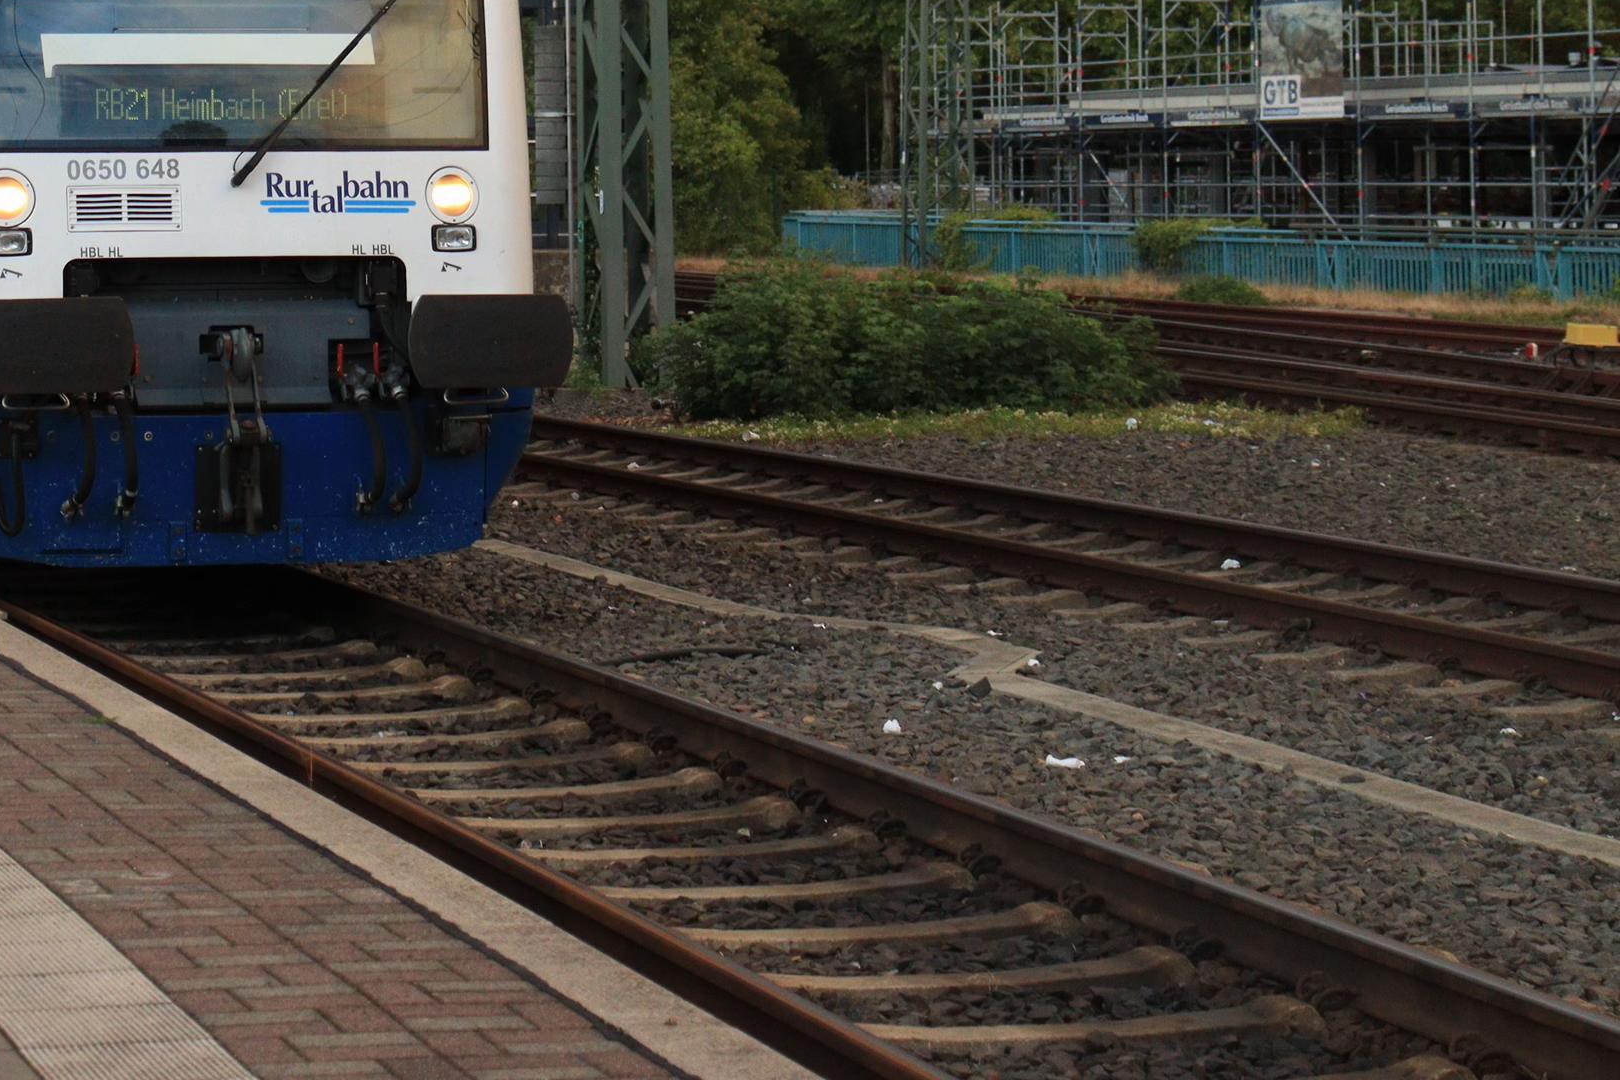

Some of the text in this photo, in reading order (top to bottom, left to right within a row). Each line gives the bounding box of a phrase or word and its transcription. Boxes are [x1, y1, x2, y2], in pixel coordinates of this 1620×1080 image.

[1264, 80, 1298, 105] GTB
[95, 88, 149, 120] RB21
[161, 88, 265, 120] Heimbach
[67, 159, 181, 180] 0650 648
[80, 246, 124, 258] HBL HL
[352, 243, 395, 256] HL HBL
